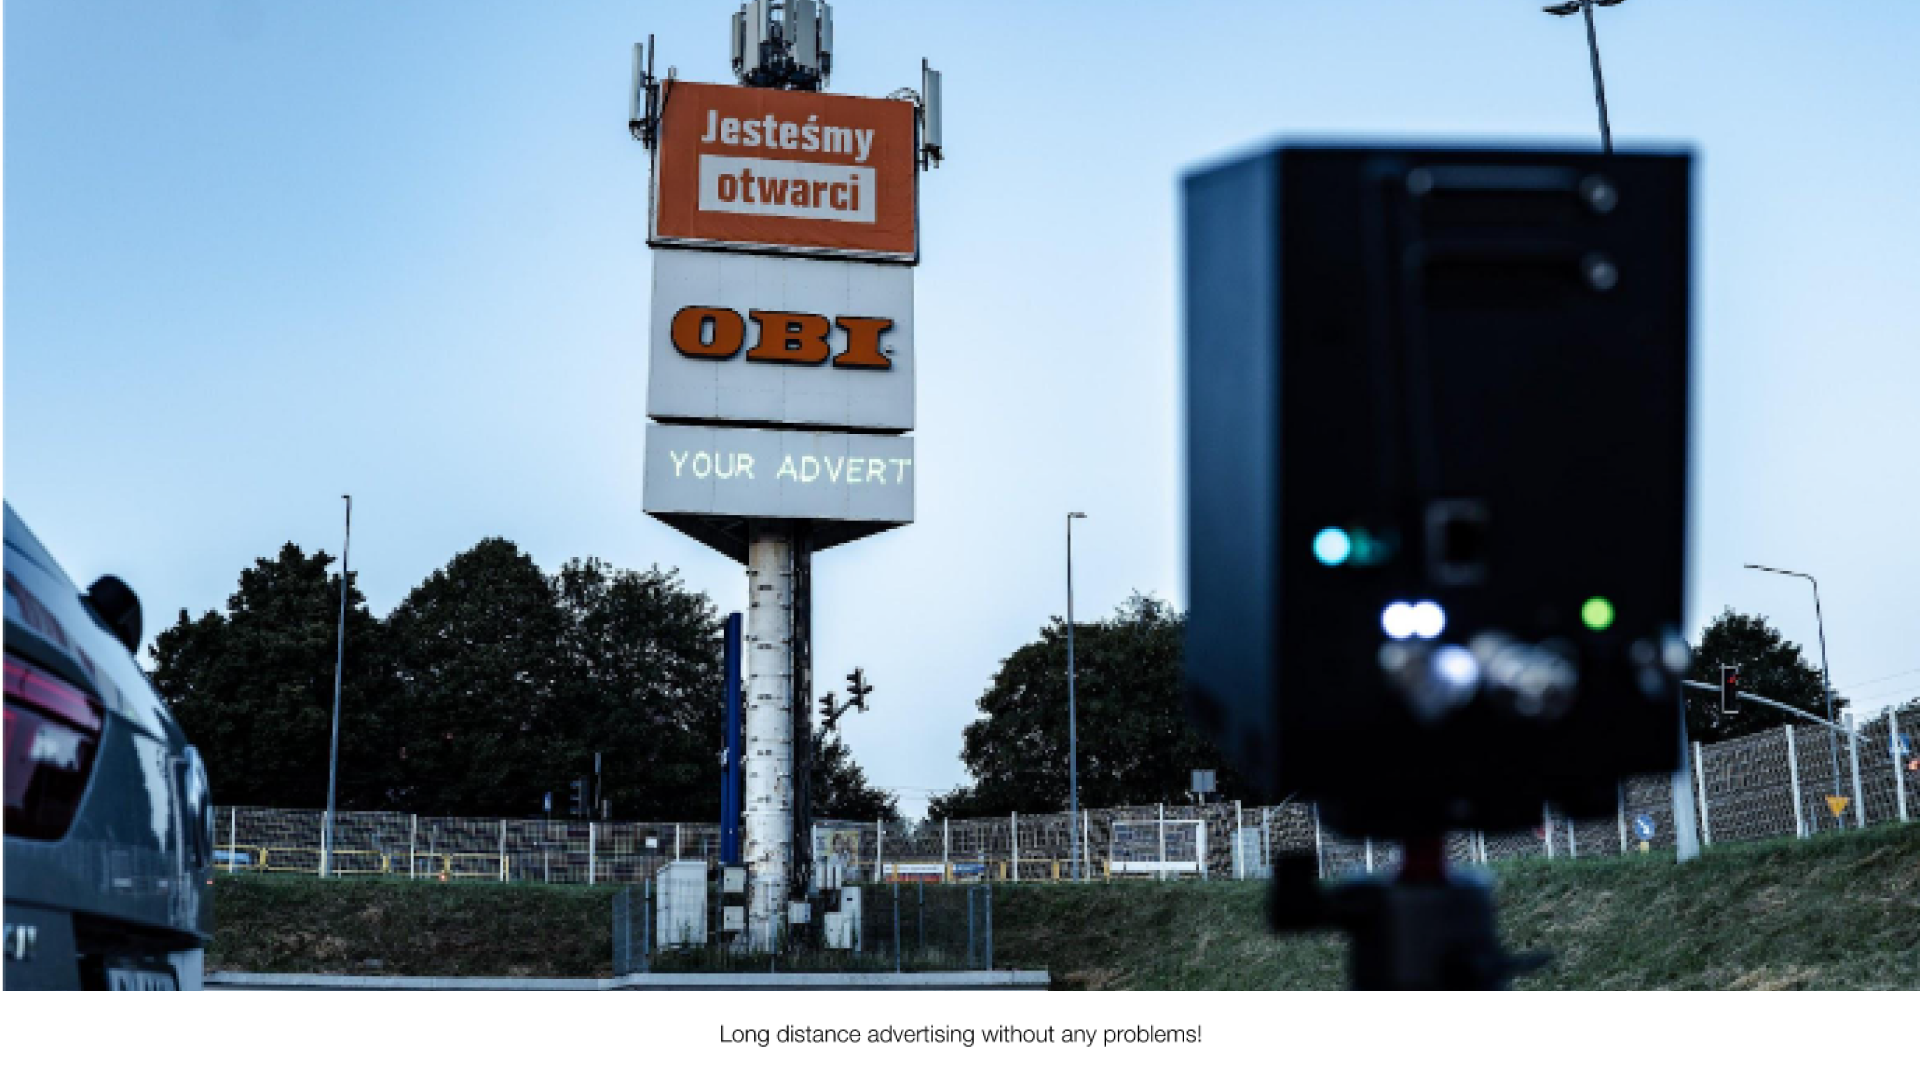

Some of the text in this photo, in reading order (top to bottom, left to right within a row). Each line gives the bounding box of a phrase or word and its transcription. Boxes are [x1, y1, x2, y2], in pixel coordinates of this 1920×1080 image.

[701, 109, 876, 163] Jesteśmy
[717, 168, 860, 211] otwarci
[670, 304, 894, 370] OBI
[669, 450, 912, 485] YOUR ADVERT
